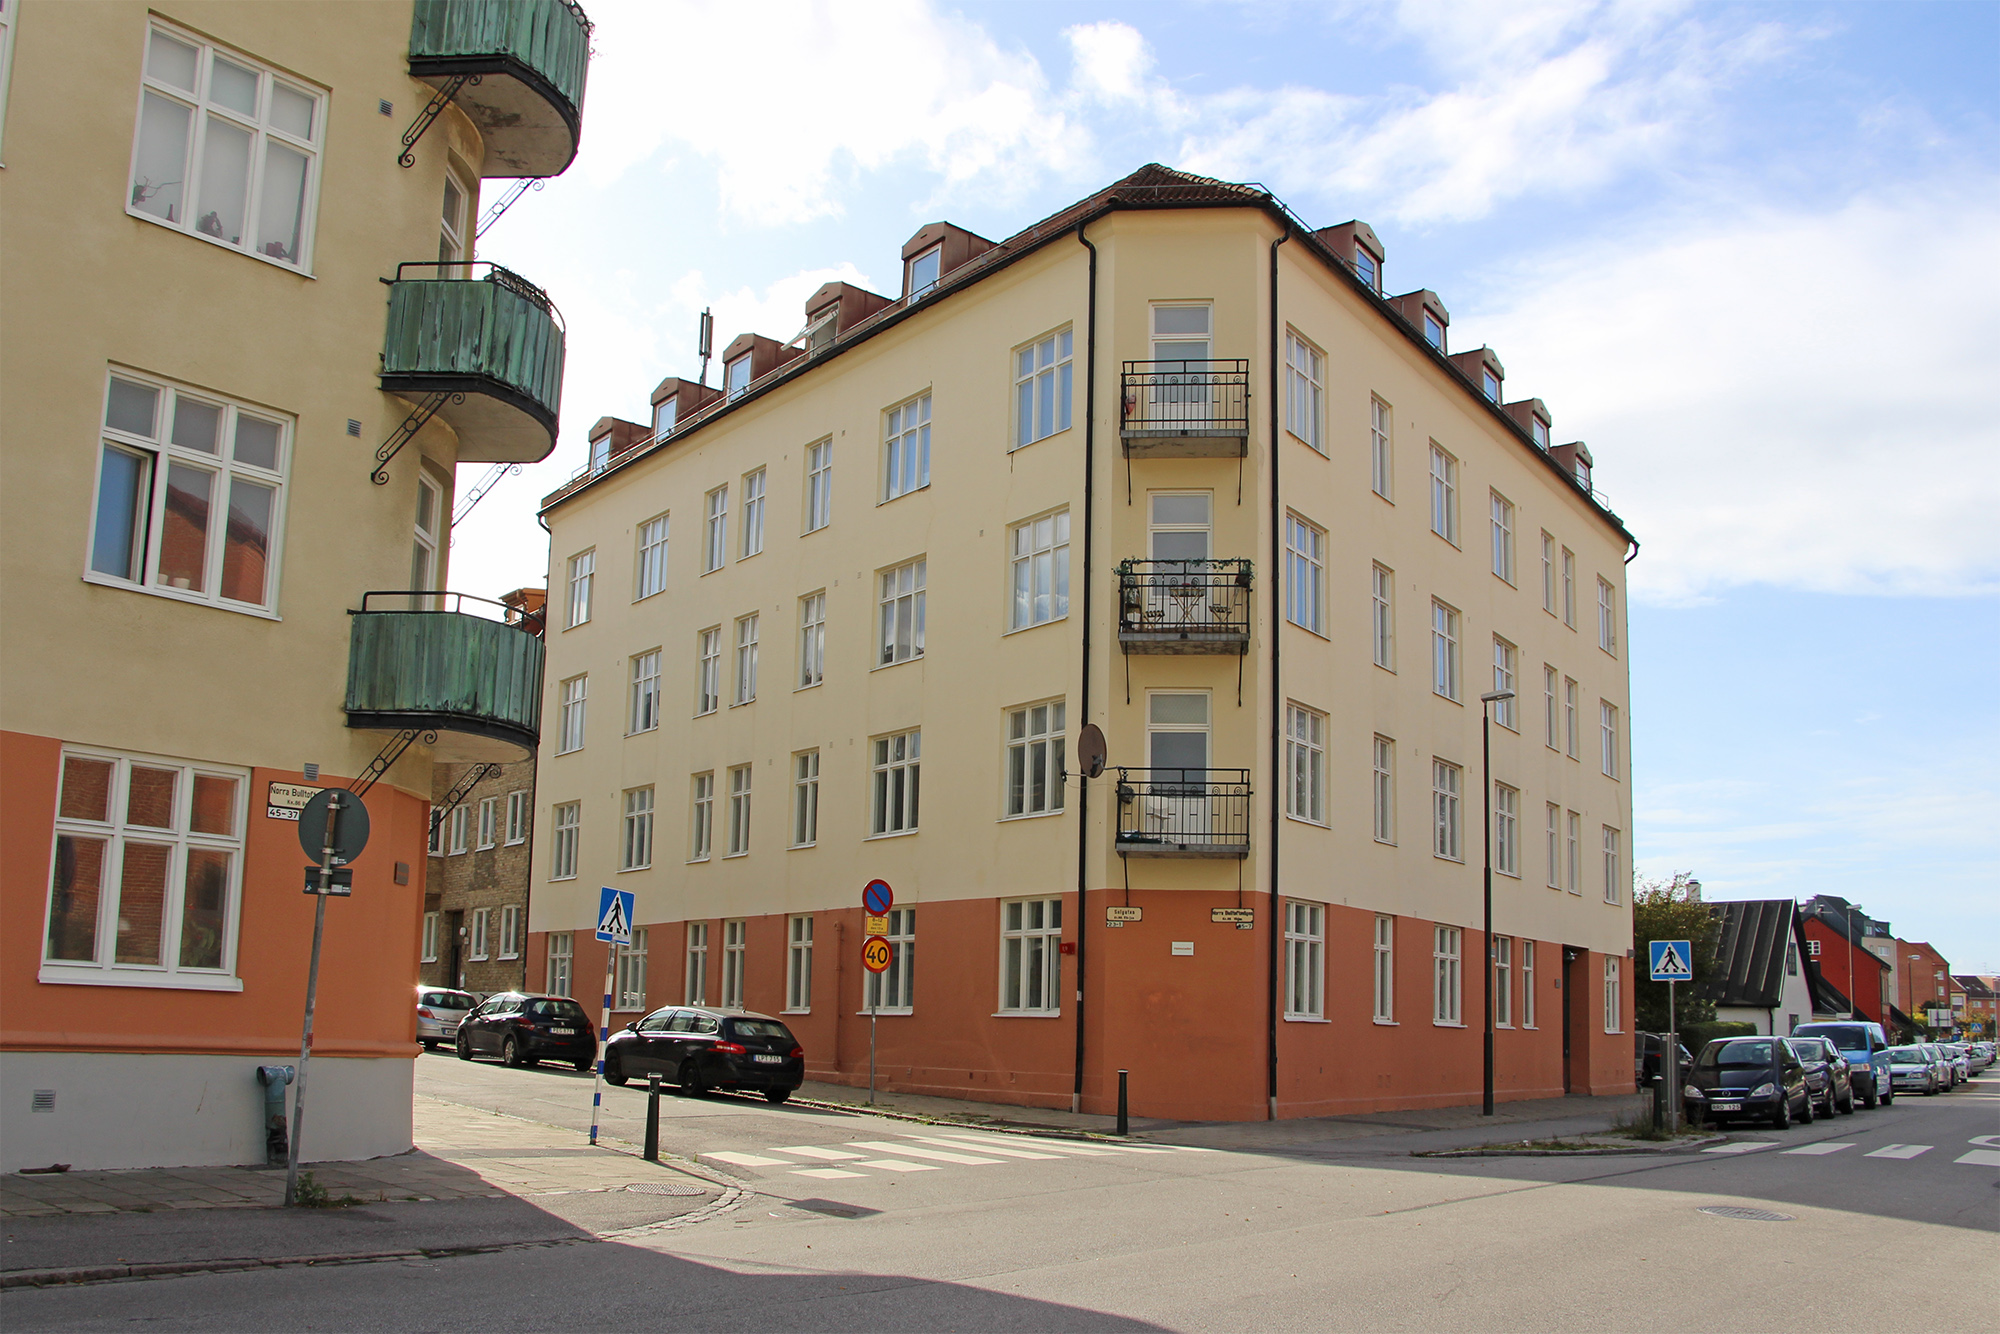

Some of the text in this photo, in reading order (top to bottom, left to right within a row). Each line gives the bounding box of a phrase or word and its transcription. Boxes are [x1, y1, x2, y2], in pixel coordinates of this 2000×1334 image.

[270, 786, 290, 796] Norra
[269, 808, 298, 819] 45-37
[866, 945, 888, 964] 40
